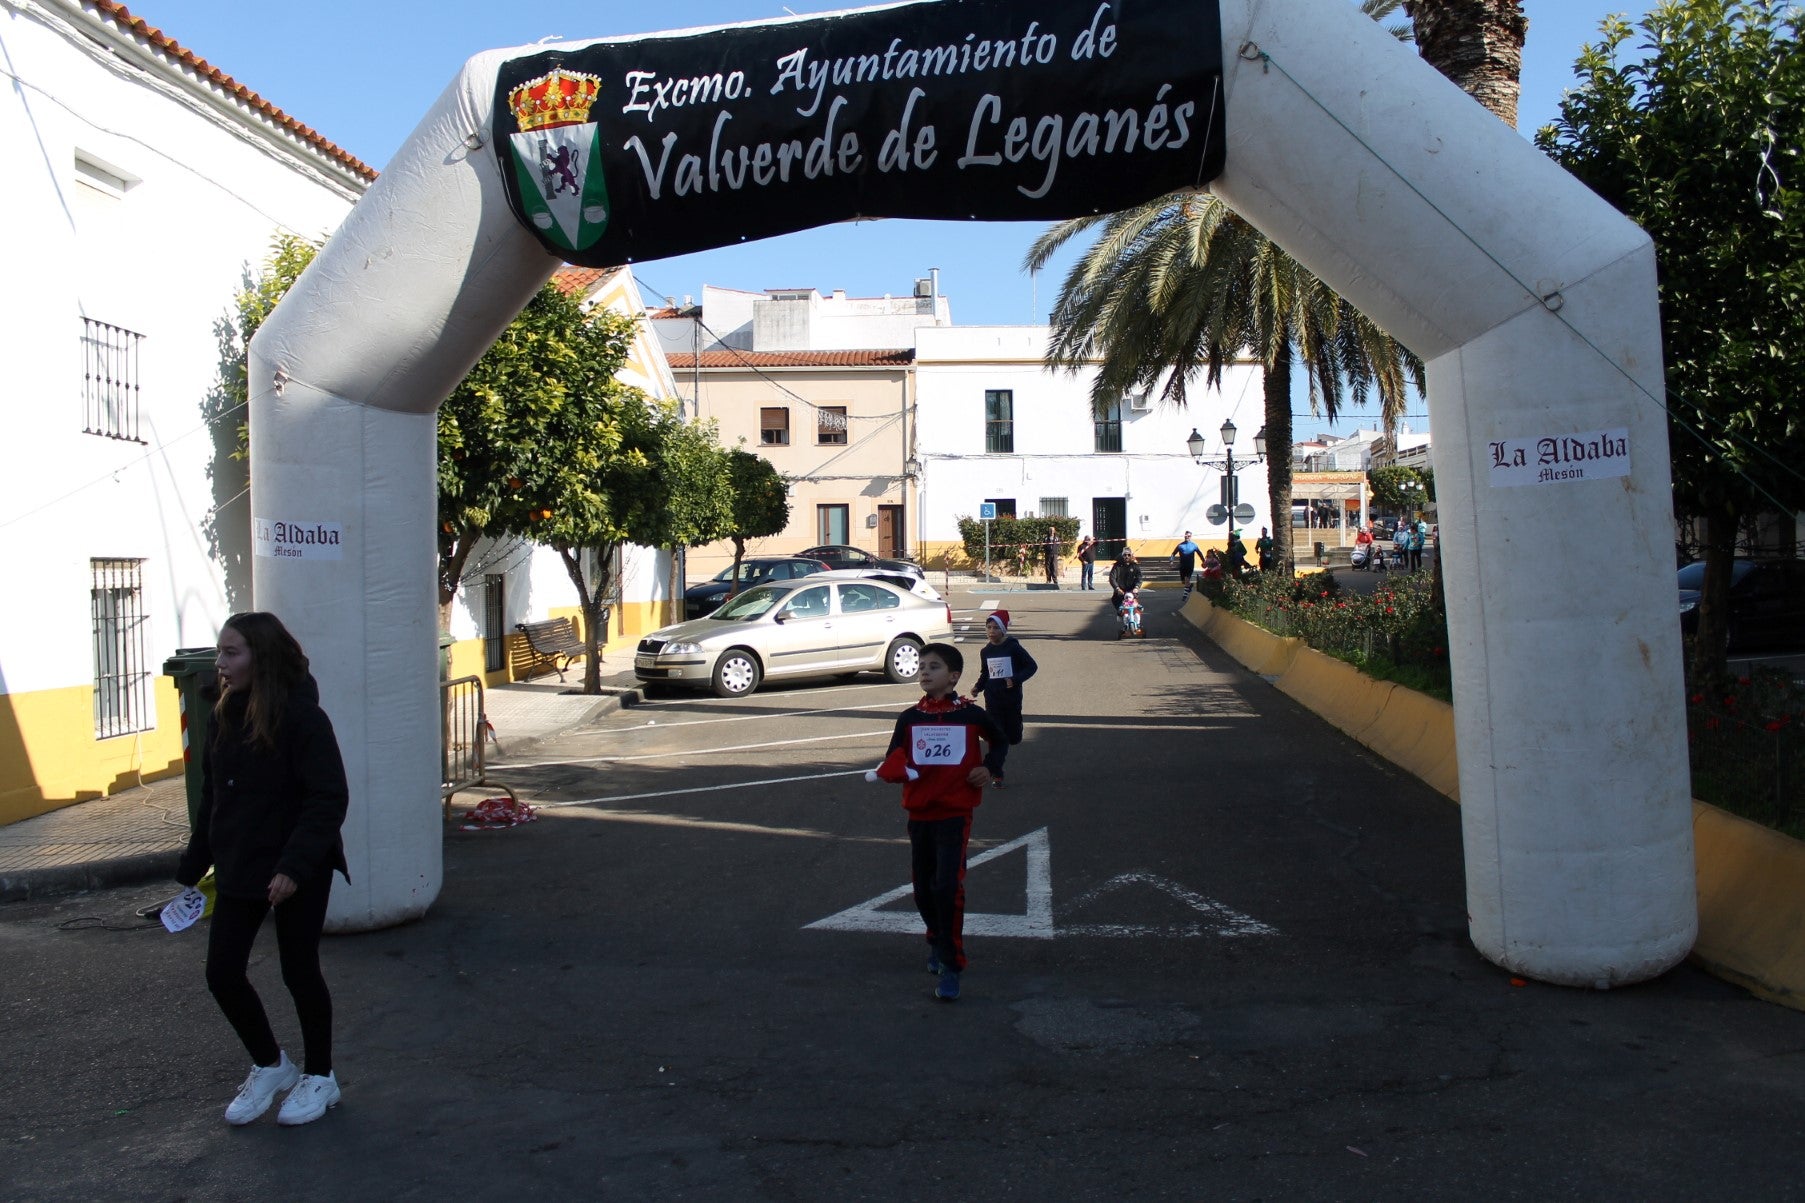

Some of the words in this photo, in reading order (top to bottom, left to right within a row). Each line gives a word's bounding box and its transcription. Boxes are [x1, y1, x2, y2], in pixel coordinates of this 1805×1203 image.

[623, 70, 751, 122] Excmo.
[770, 21, 1057, 116] Ayuntamiento
[1071, 3, 1118, 60] de
[623, 95, 862, 200] Valverde
[877, 87, 938, 172] de
[957, 83, 1195, 199] Leganés
[1489, 441, 1527, 468] La
[1536, 433, 1627, 466] Aldaba
[1538, 465, 1584, 483] Mesón
[256, 521, 270, 542] La
[274, 521, 340, 545] Aldaba
[274, 545, 303, 558] Mesón
[925, 744, 951, 758] 026
